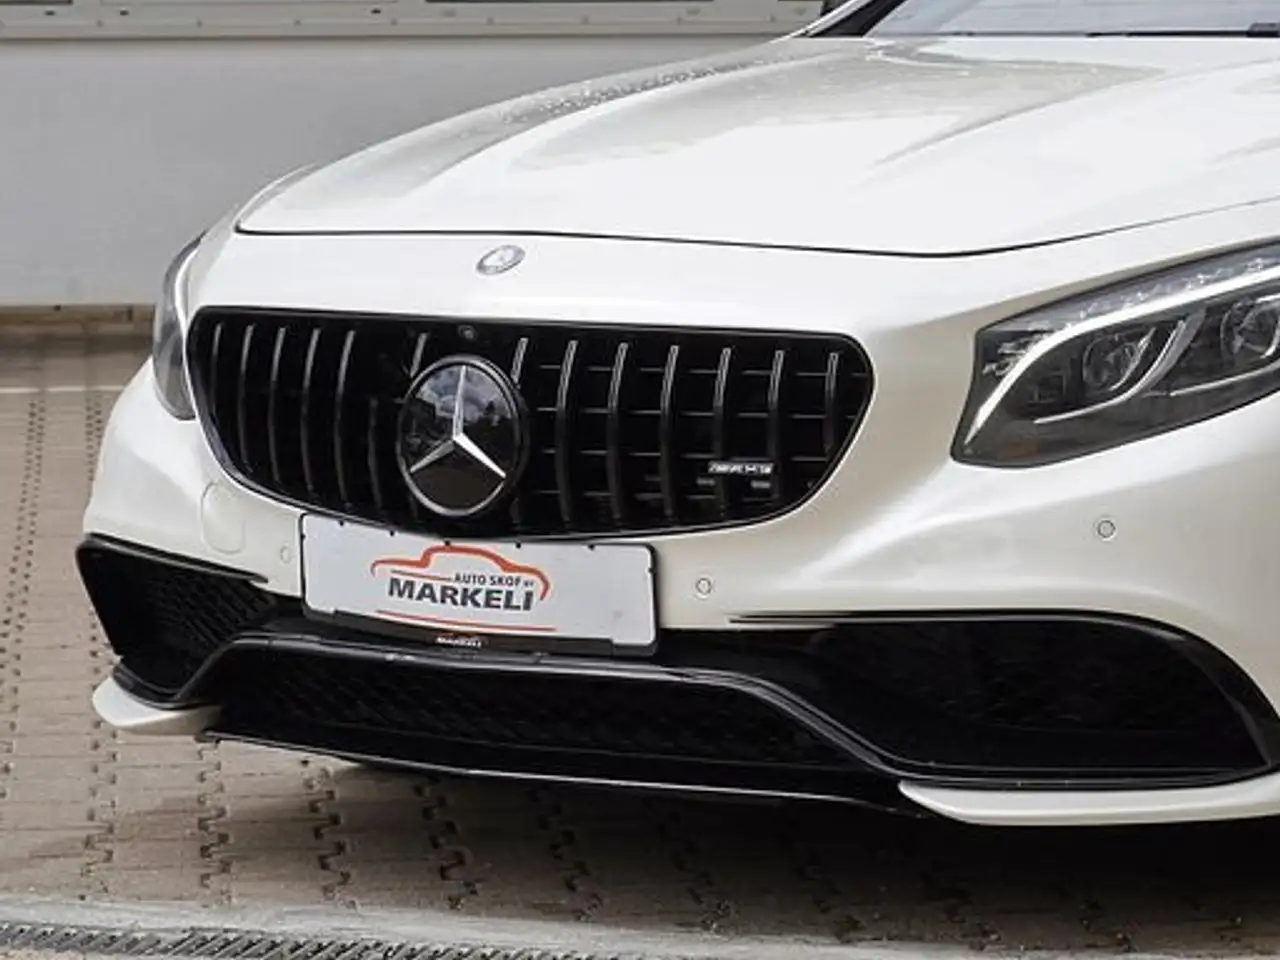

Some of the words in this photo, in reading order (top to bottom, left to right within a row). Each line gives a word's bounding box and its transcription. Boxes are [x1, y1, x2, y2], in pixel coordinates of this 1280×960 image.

[453, 572, 486, 585] AUTO
[489, 575, 522, 587] SKOF
[388, 577, 533, 611] MARKELI
